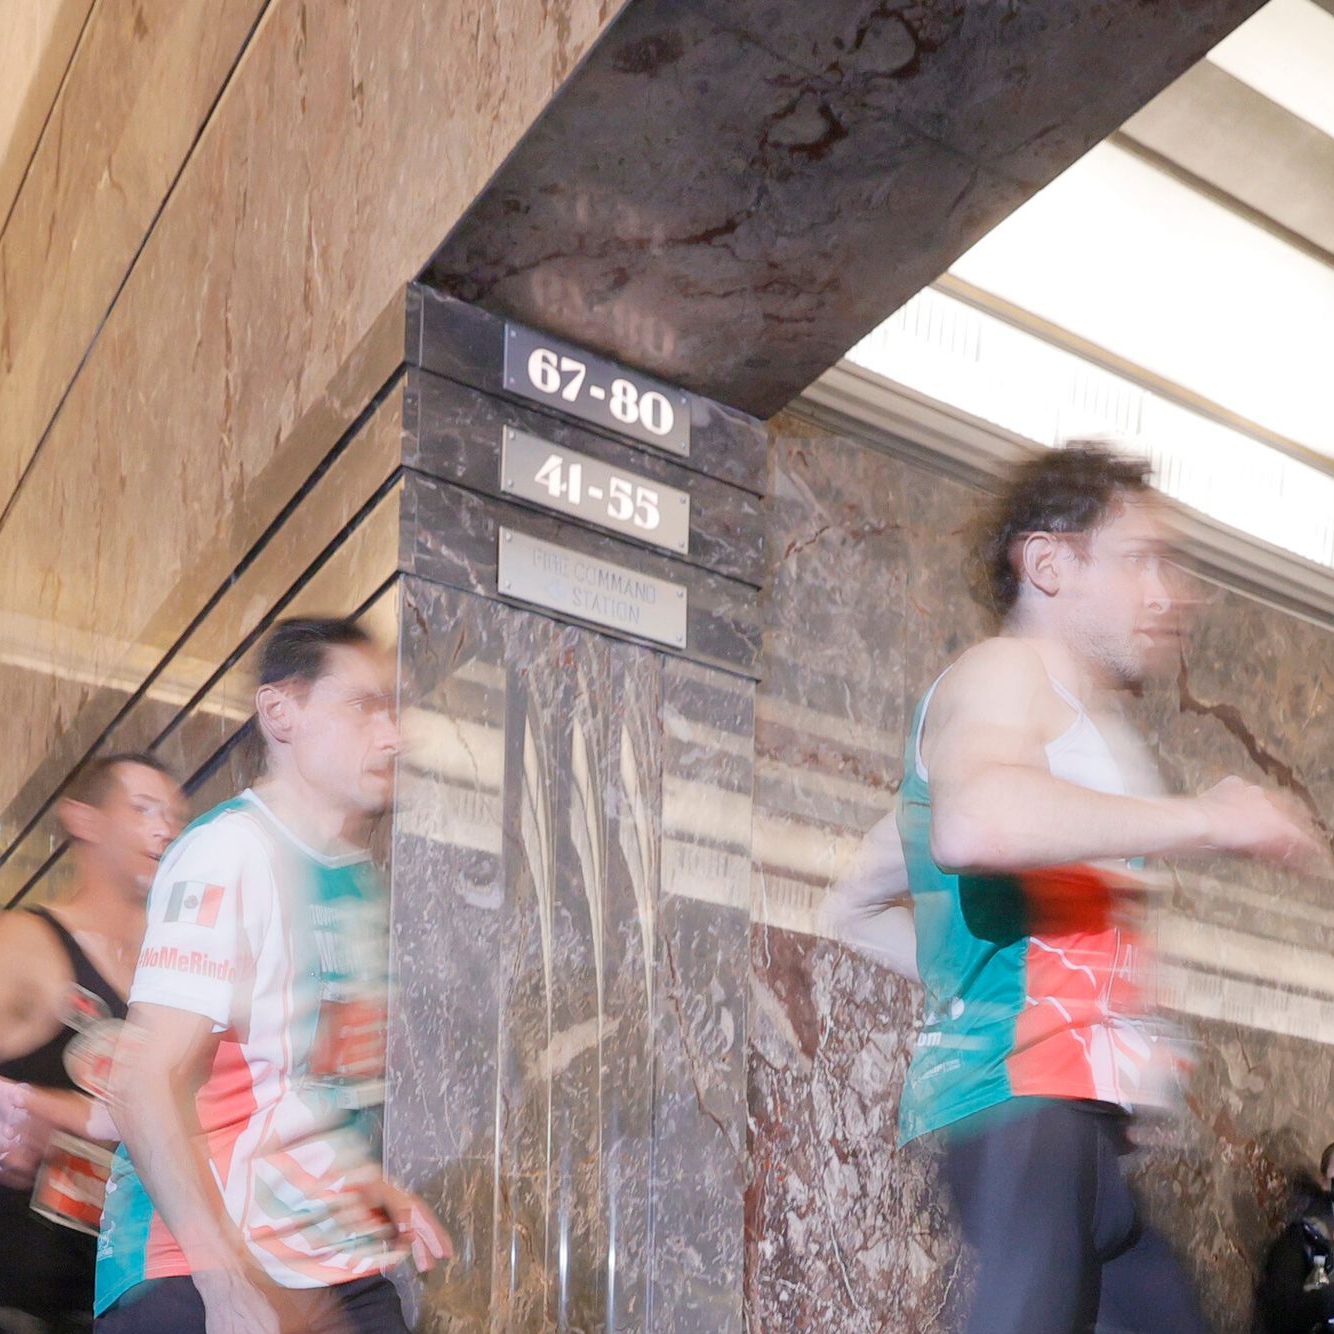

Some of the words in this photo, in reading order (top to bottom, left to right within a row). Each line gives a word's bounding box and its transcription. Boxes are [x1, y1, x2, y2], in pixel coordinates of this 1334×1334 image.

[527, 348, 675, 436] 67-80
[534, 454, 660, 530] 41-55
[572, 588, 640, 625] STATION
[574, 562, 657, 605] COMMAND
